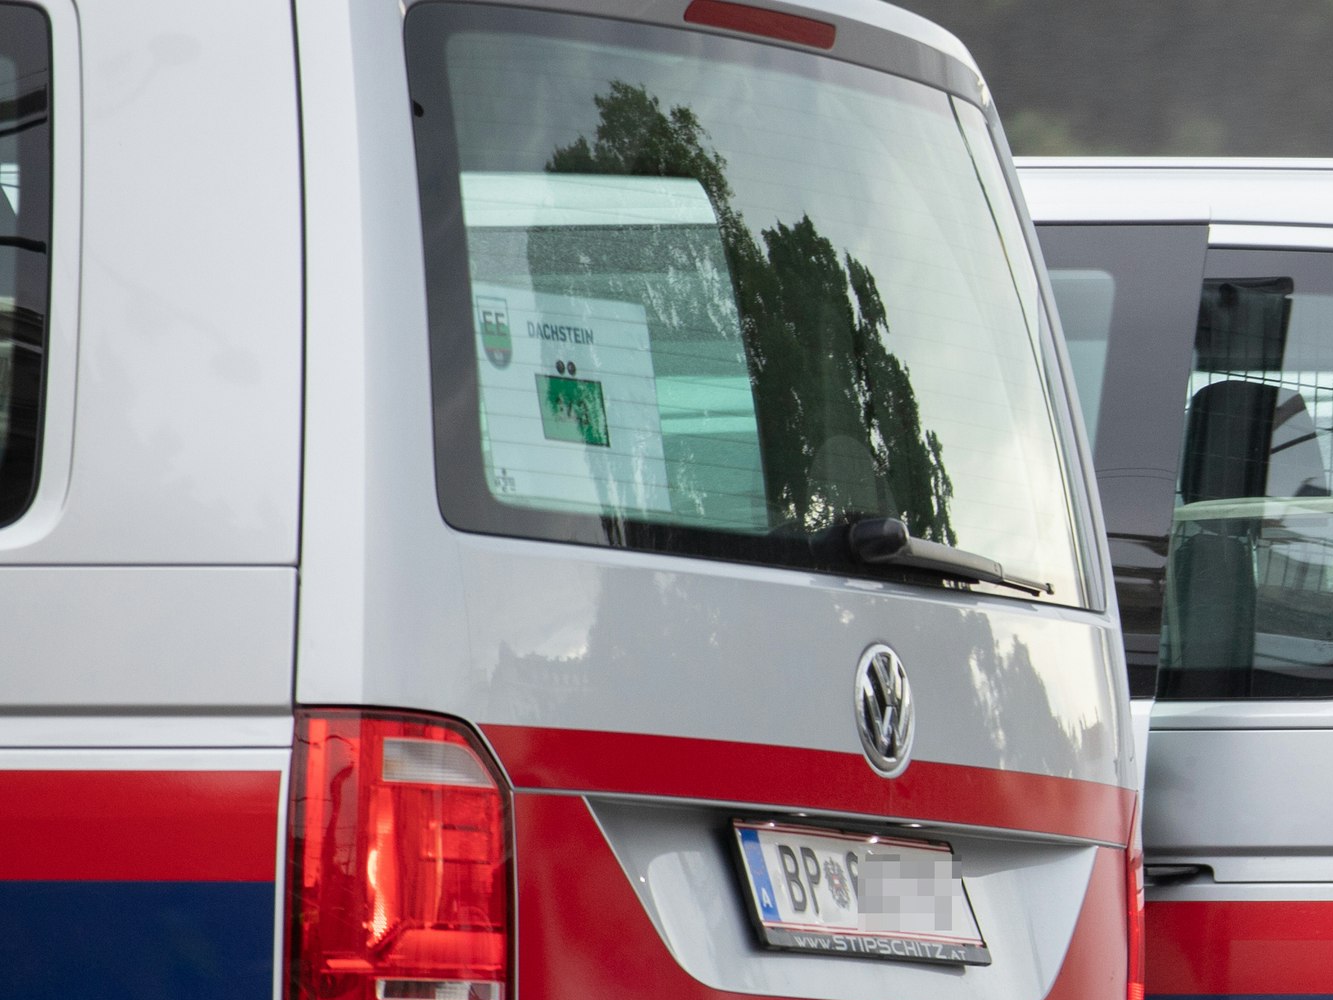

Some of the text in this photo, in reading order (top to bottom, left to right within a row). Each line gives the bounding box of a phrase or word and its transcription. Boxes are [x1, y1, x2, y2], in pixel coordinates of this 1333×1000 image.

[482, 310, 507, 337] EE
[527, 321, 594, 345] DACHSTEIN
[777, 844, 821, 915] BP
